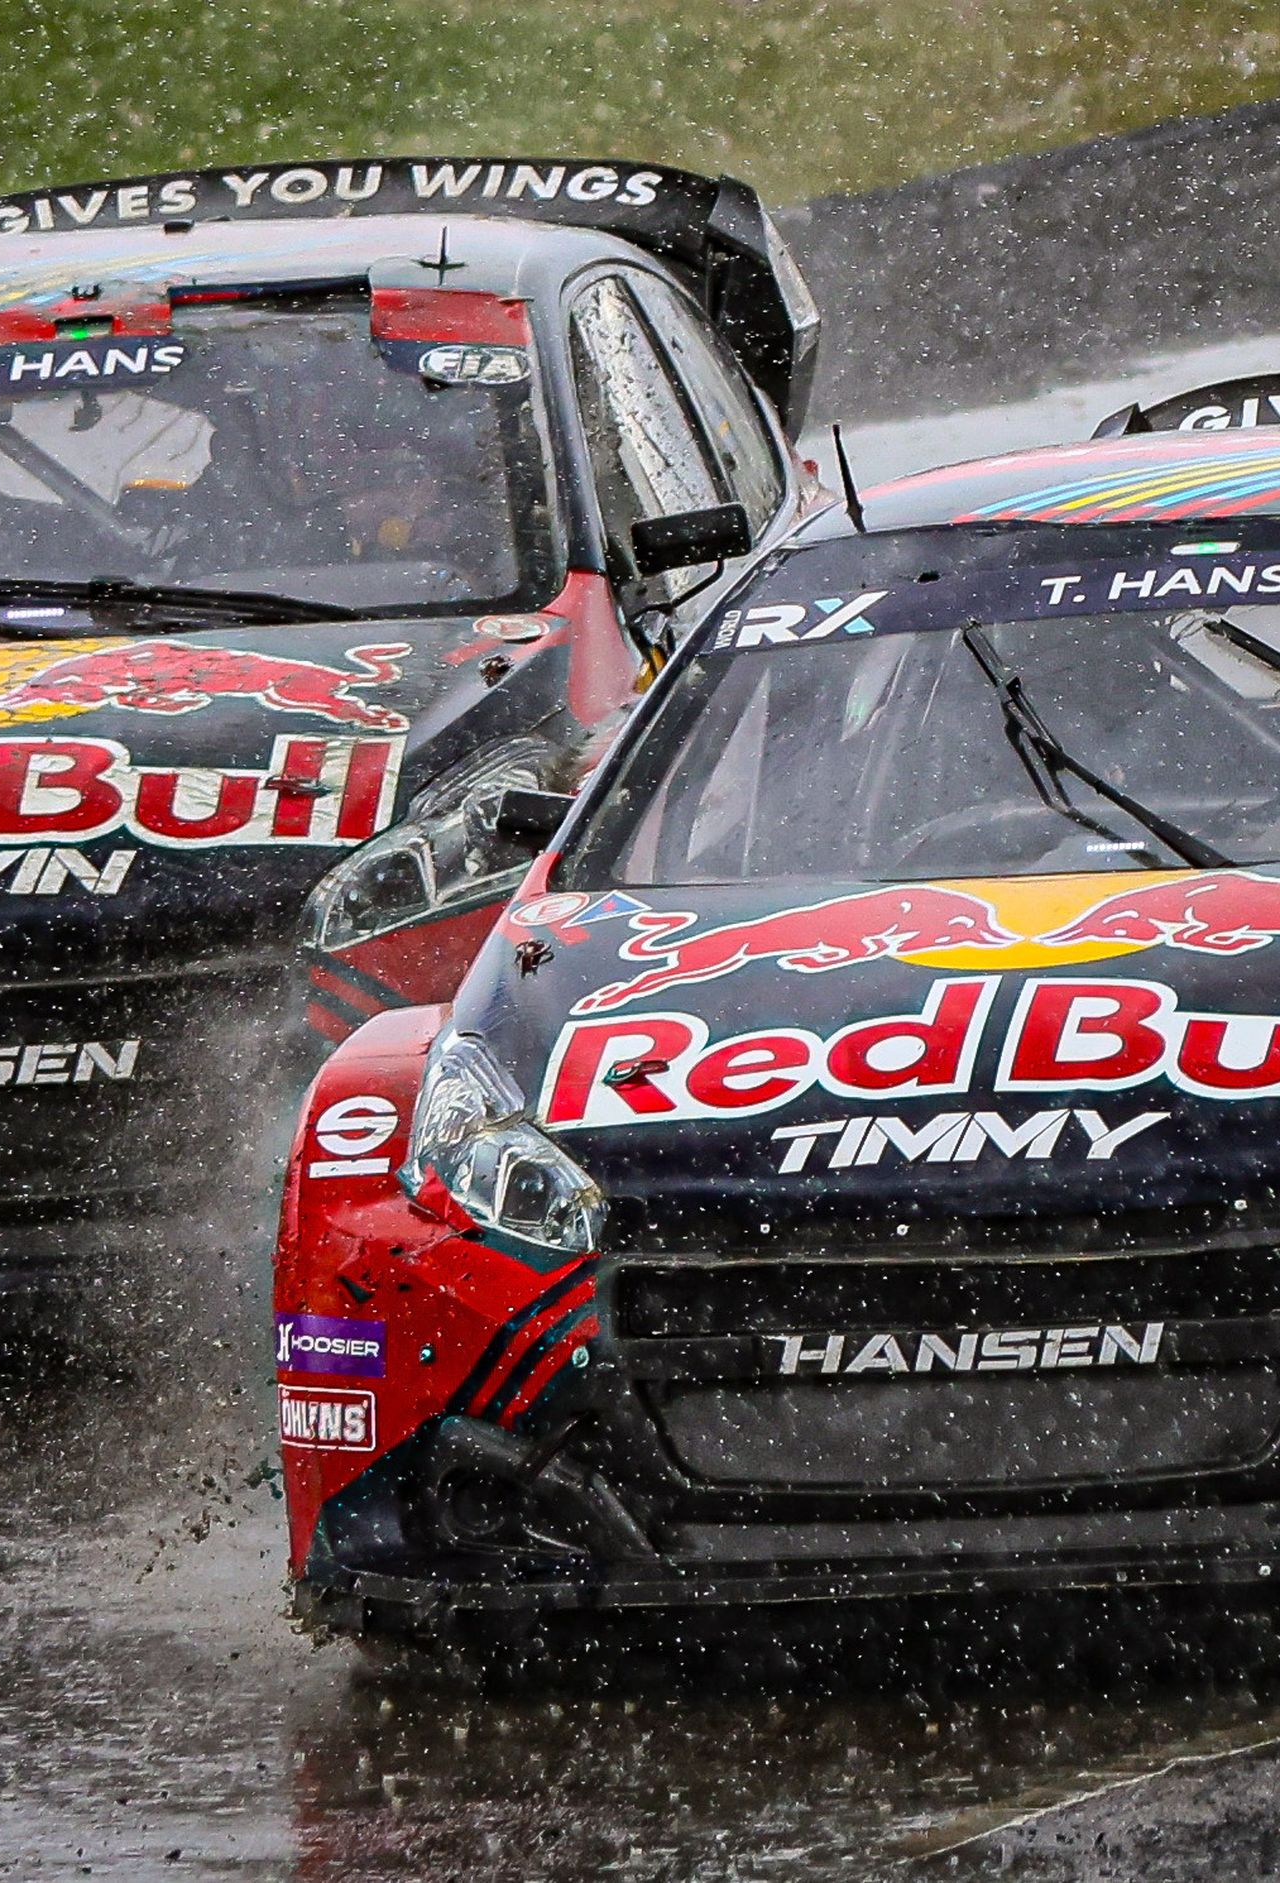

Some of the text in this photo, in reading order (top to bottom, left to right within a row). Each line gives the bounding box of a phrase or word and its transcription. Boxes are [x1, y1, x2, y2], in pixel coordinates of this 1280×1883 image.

[223, 164, 384, 206] YOU
[410, 163, 662, 207] WINGS
[10, 345, 185, 381] HANS
[425, 349, 526, 380] FIA
[1041, 574, 1086, 606] T.
[735, 590, 890, 648] RX
[543, 979, 987, 1125] Red
[771, 1109, 1172, 1174] TIMMY
[291, 1334, 380, 1358] HOOSIER
[781, 1322, 1164, 1376] HANSEN
